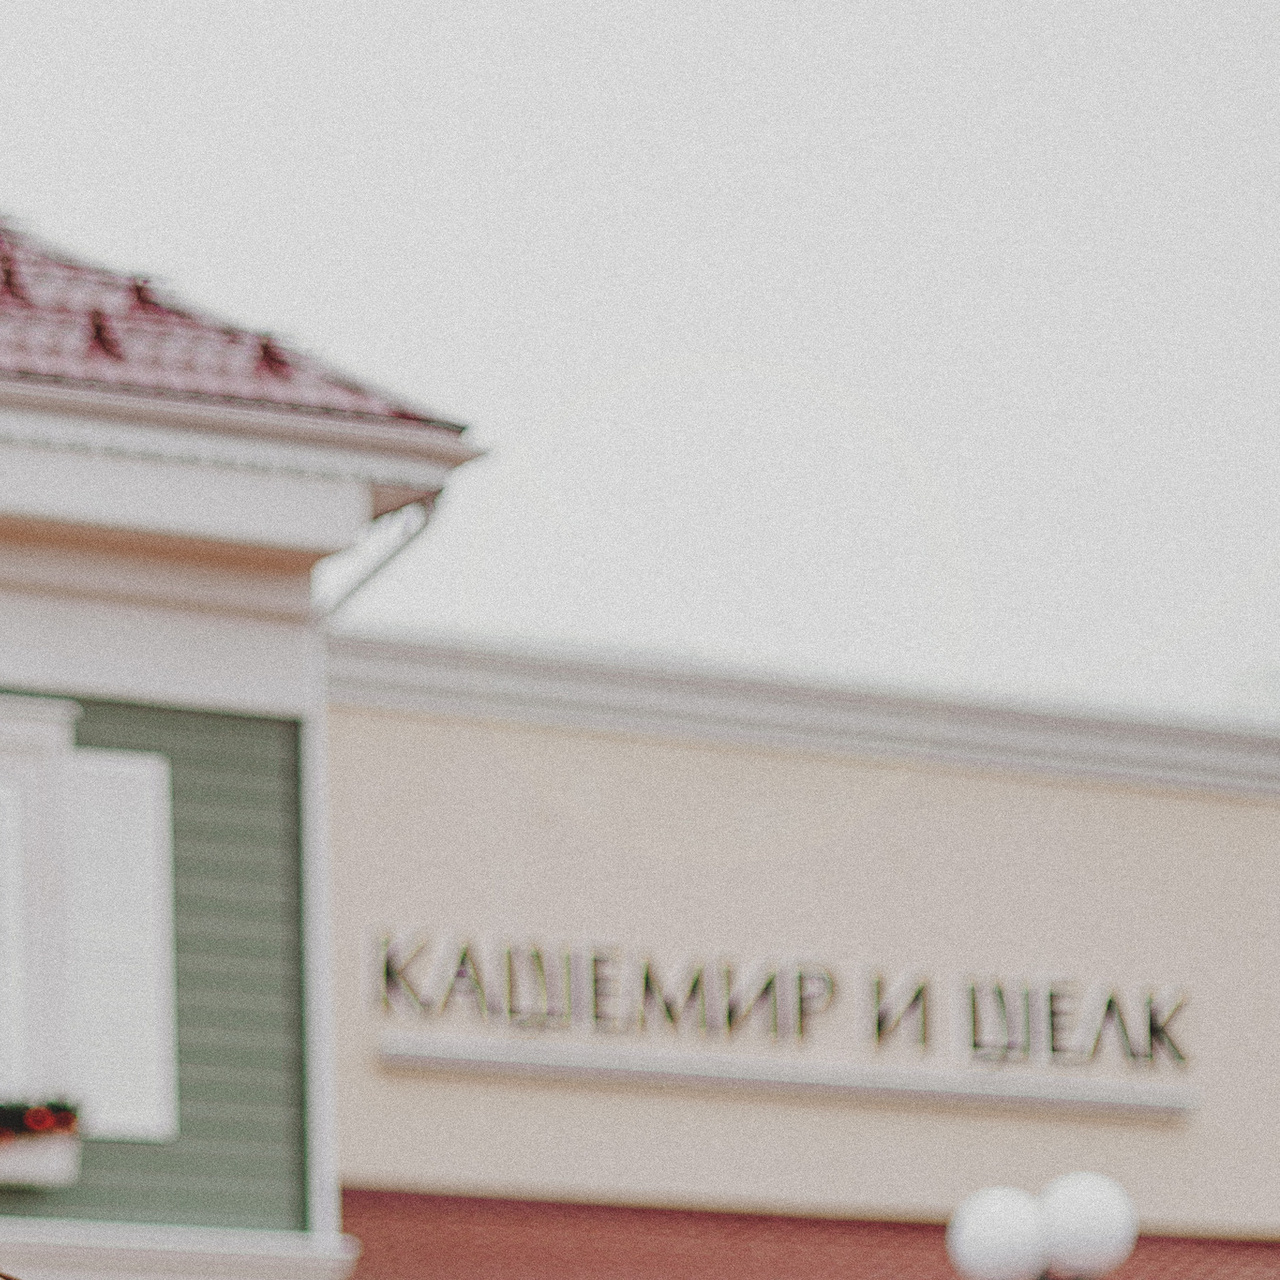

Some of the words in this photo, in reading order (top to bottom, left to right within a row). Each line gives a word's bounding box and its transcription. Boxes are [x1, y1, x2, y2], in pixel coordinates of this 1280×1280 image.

[380, 935, 838, 1042] КАШЕМИР
[872, 975, 932, 1052] И
[968, 978, 1188, 1065] ШЕЛК
